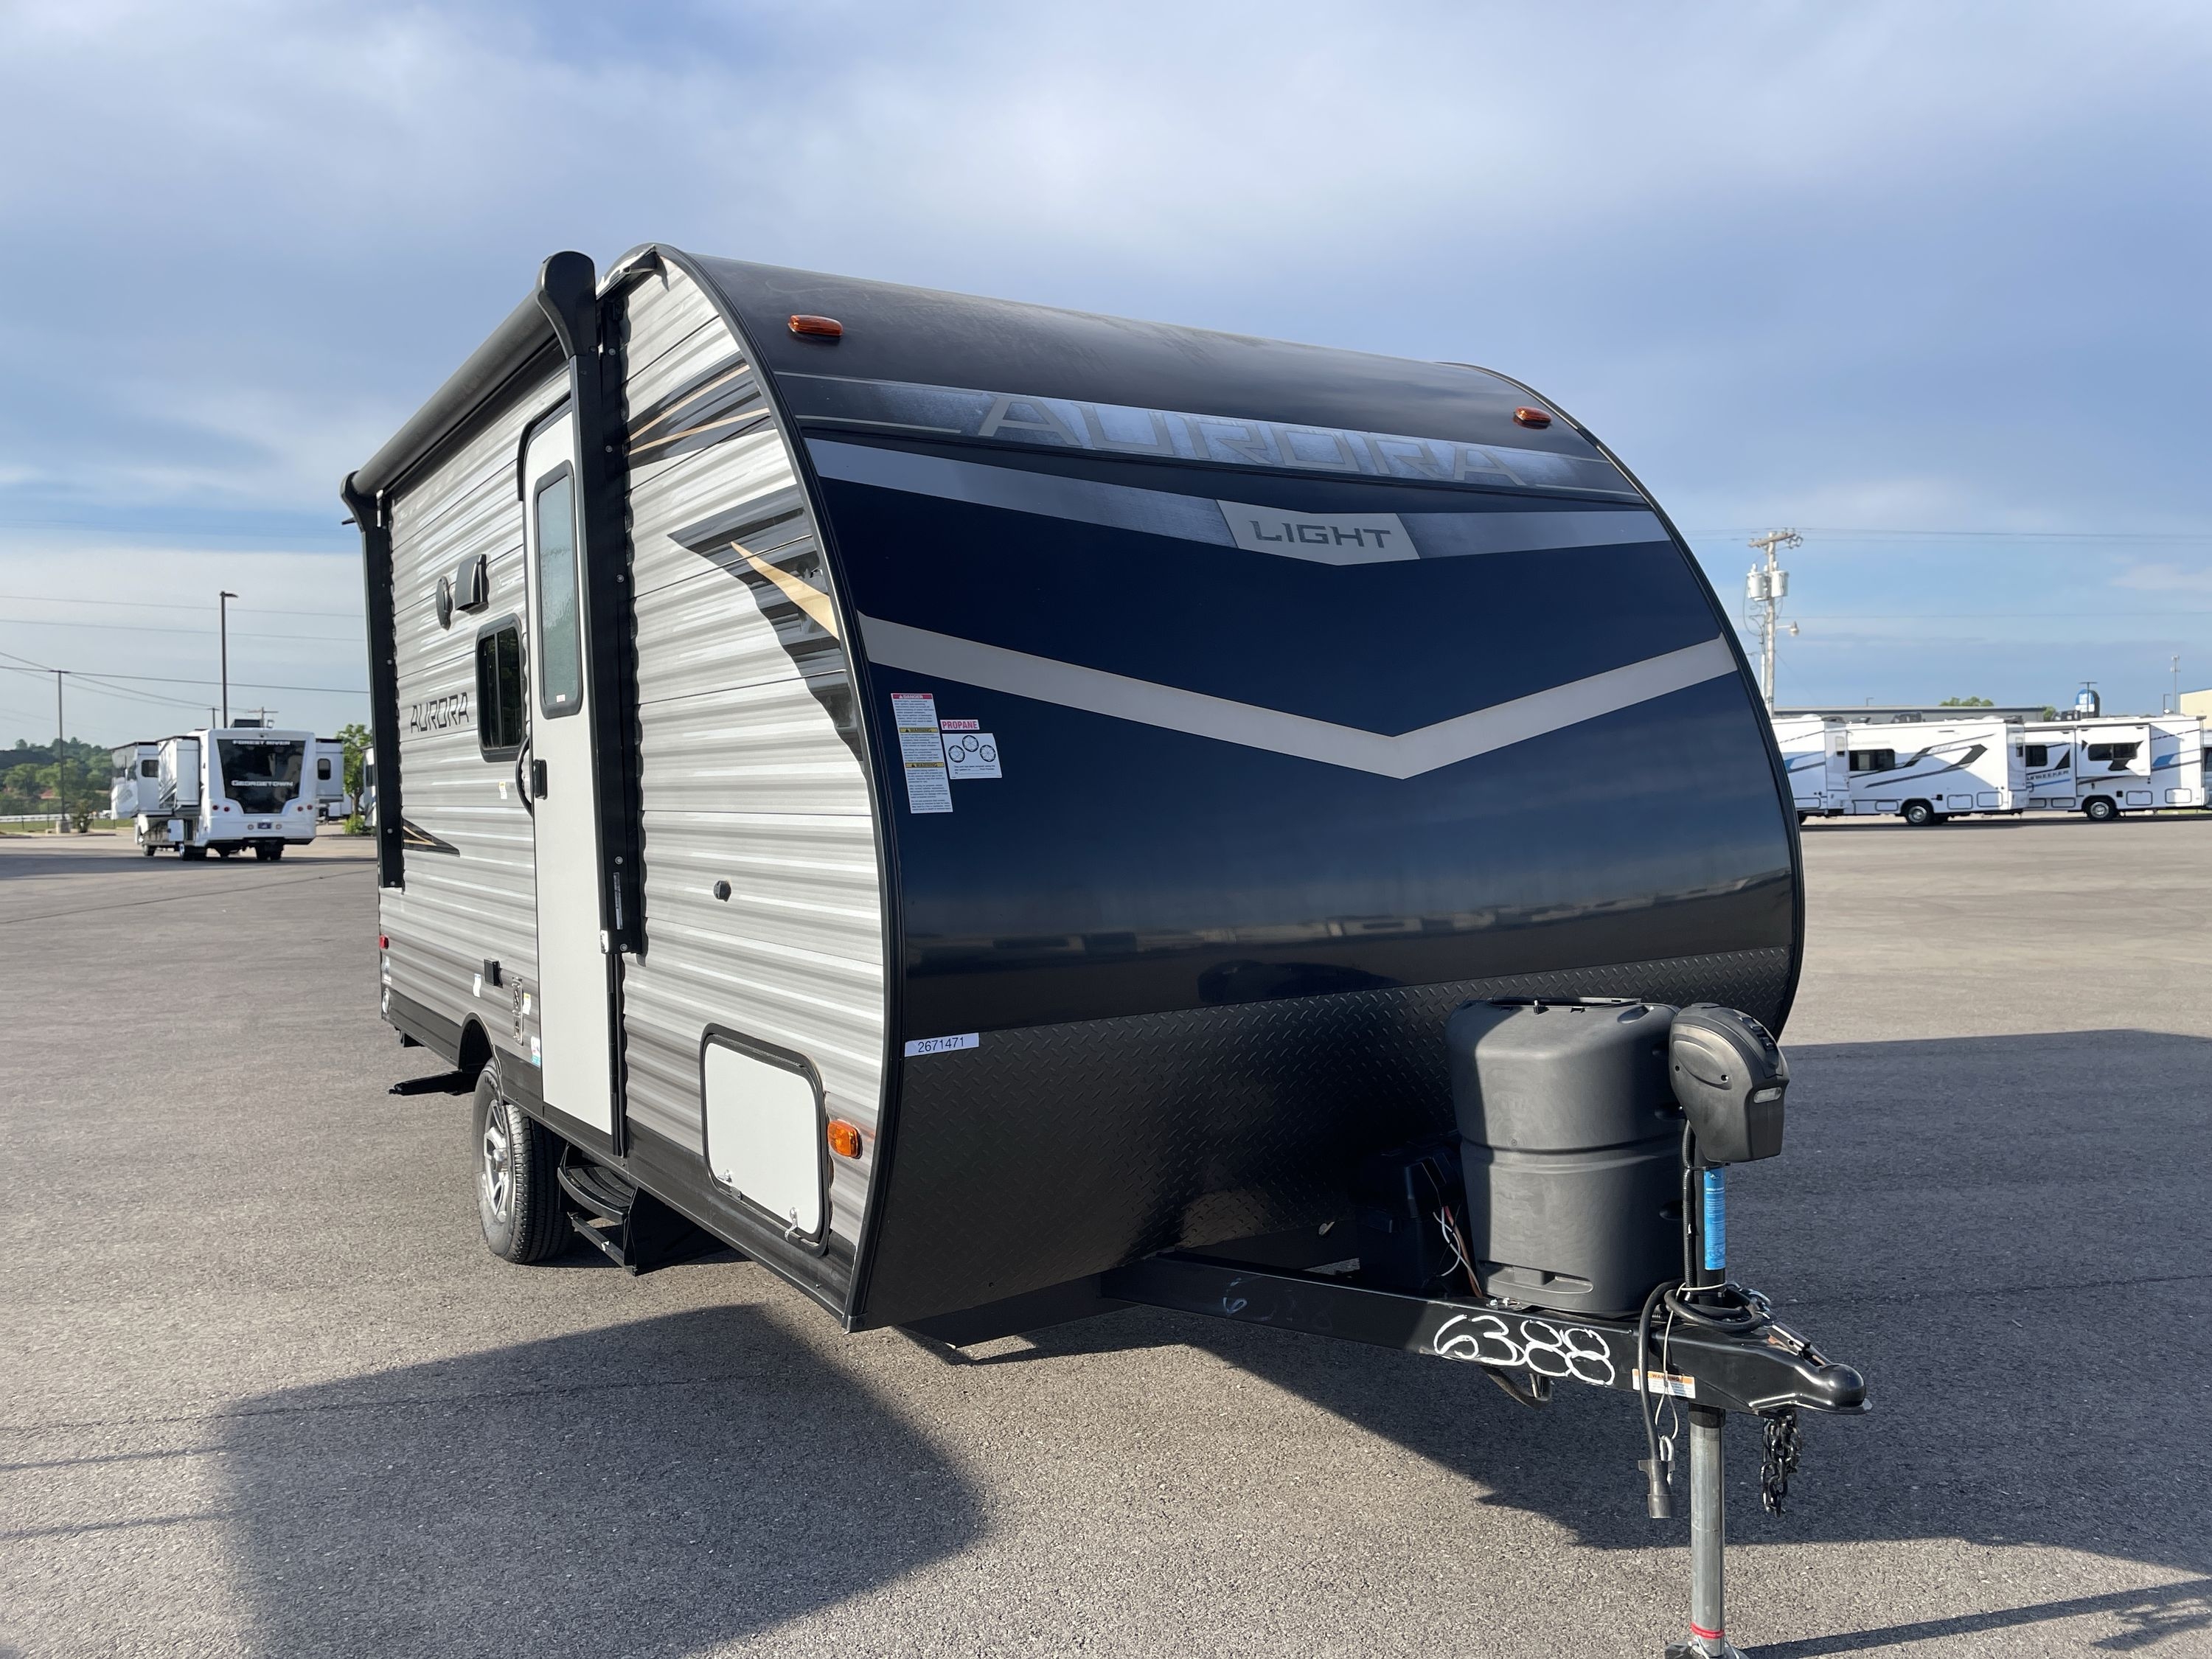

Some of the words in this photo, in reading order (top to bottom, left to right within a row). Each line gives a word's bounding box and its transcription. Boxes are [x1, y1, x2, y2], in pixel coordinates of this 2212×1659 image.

[978, 394, 1526, 487] AURORA
[1250, 520, 1391, 549] LIGHT
[411, 692, 470, 734] AURORA
[942, 721, 978, 729] PROPANE
[918, 1037, 964, 1053] 2671471
[1433, 1314, 1615, 1386] 6388
